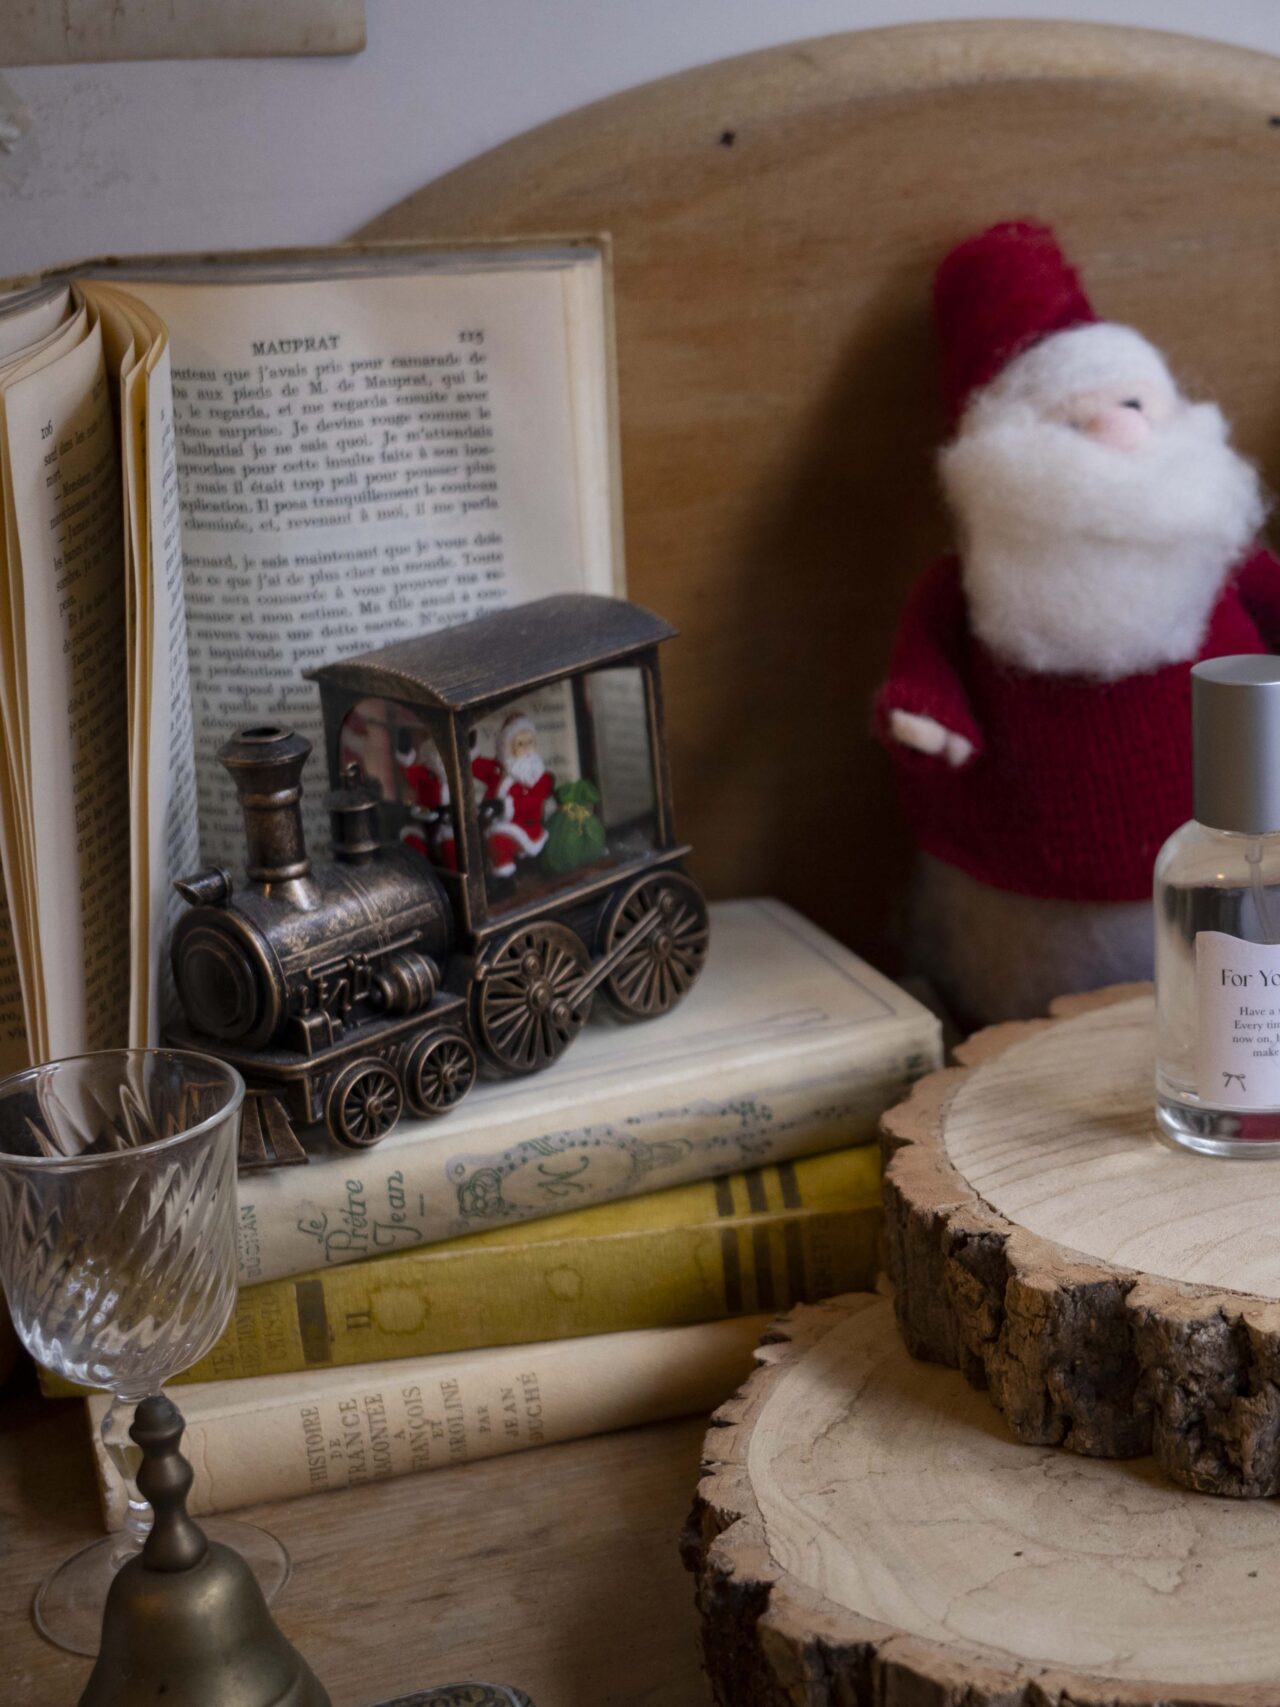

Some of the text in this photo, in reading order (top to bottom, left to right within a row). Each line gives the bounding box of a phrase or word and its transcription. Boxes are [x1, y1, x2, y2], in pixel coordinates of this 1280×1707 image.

[252, 334, 340, 356] MAUPRAT
[171, 351, 487, 385] outeau que j'avais pris pour camarade de
[197, 388, 222, 400] aux
[233, 385, 272, 405] pieds
[282, 383, 299, 397] de
[338, 379, 354, 392] de
[365, 373, 432, 391] Mauprat,
[441, 372, 465, 390] qui
[474, 370, 488, 383] le
[209, 403, 270, 422] regarda,
[278, 403, 292, 416] et
[302, 402, 324, 415] me
[332, 395, 388, 413] regarda
[396, 391, 448, 404] ensuite
[41, 419, 54, 440] 106
[219, 423, 282, 441] surprise.
[292, 420, 308, 438] Je
[316, 415, 364, 432] devins
[371, 412, 411, 430] rouge
[419, 410, 471, 423] comme
[478, 406, 491, 419] le
[252, 442, 266, 460] je
[275, 443, 292, 455] ne
[300, 438, 327, 451] sais
[336, 433, 373, 452] quoi.
[383, 430, 397, 447] Je
[406, 425, 493, 442] m'attendais
[177, 462, 235, 477] eproches
[242, 462, 277, 479] pour
[283, 459, 319, 473] cette
[326, 453, 374, 469] insulte
[380, 449, 412, 464] faite
[433, 446, 458, 458] son
[196, 481, 228, 495] mais
[250, 478, 285, 493] était
[293, 476, 324, 491] trop
[331, 471, 358, 490] poli
[365, 470, 398, 487] pour
[466, 460, 496, 477] plus
[179, 498, 253, 514] xplication.
[312, 486, 419, 507] tranquillement
[425, 482, 437, 495] le
[441, 480, 498, 494] couteau
[432, 501, 454, 514] me
[461, 496, 499, 514] parla
[295, 546, 378, 566] maintenant
[385, 544, 411, 560] que
[435, 536, 467, 549] vous
[1221, 968, 1253, 987] For
[1234, 1019, 1262, 1032] Every
[1239, 1006, 1266, 1016] Have
[1232, 1035, 1253, 1044] now
[1252, 1047, 1279, 1057] make
[325, 1179, 369, 1262] Prêtre
[373, 1170, 422, 1246] Jean
[297, 1211, 328, 1244] Le
[401, 1385, 431, 1471] FRANÇOIS
[477, 1404, 491, 1433] PAR
[500, 1387, 519, 1438] JEAN
[338, 1398, 368, 1484] FRANCE
[393, 1428, 406, 1441] A
[430, 1420, 444, 1440] ET
[329, 1438, 342, 1460] DE
